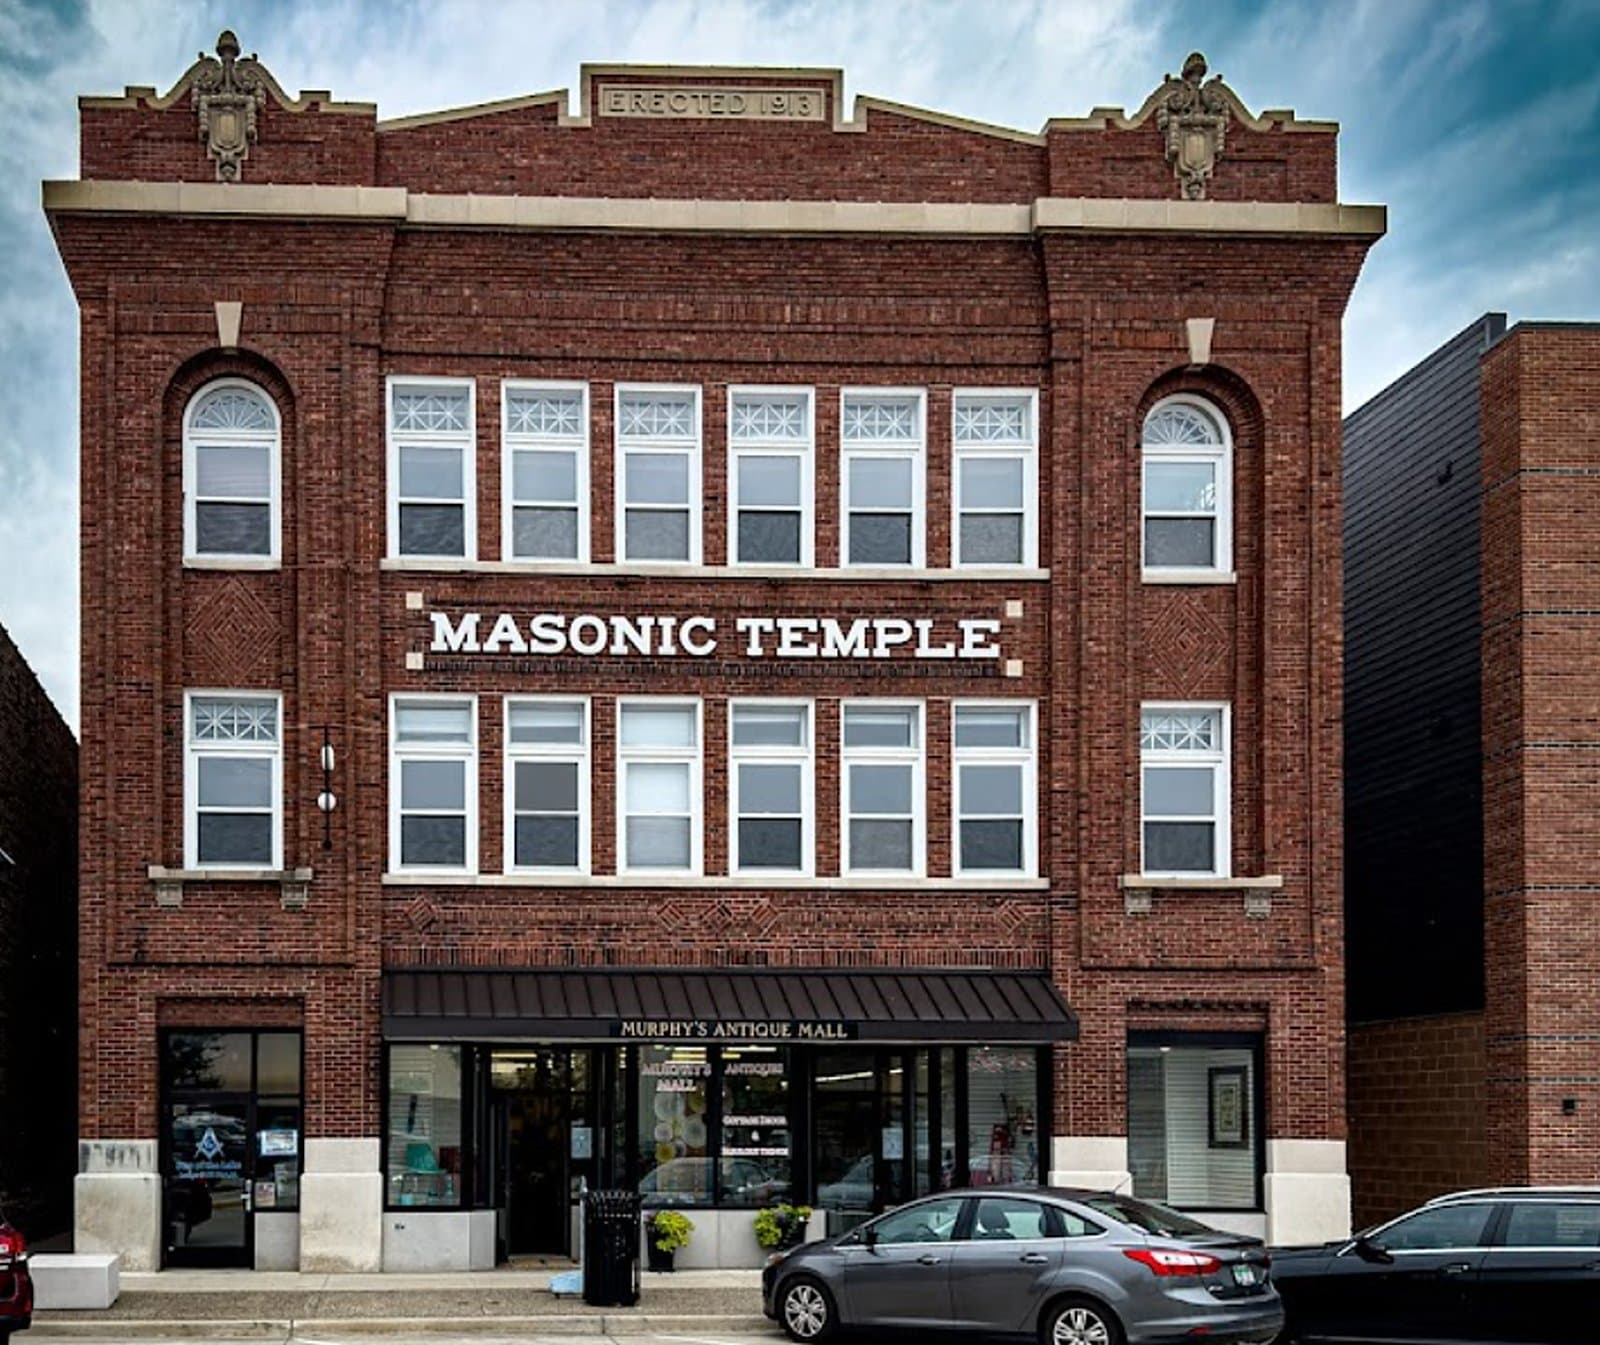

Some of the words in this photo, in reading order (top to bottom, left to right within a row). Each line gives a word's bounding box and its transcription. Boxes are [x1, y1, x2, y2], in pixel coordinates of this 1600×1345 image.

[608, 92, 747, 115] ERECTED
[760, 94, 813, 117] 1913
[430, 612, 717, 656] MASONIC
[736, 617, 1001, 659] TEMPLE
[620, 1020, 708, 1037] MURPHY'S
[713, 1022, 792, 1038] ANTIQUE
[799, 1023, 849, 1038] MALL
